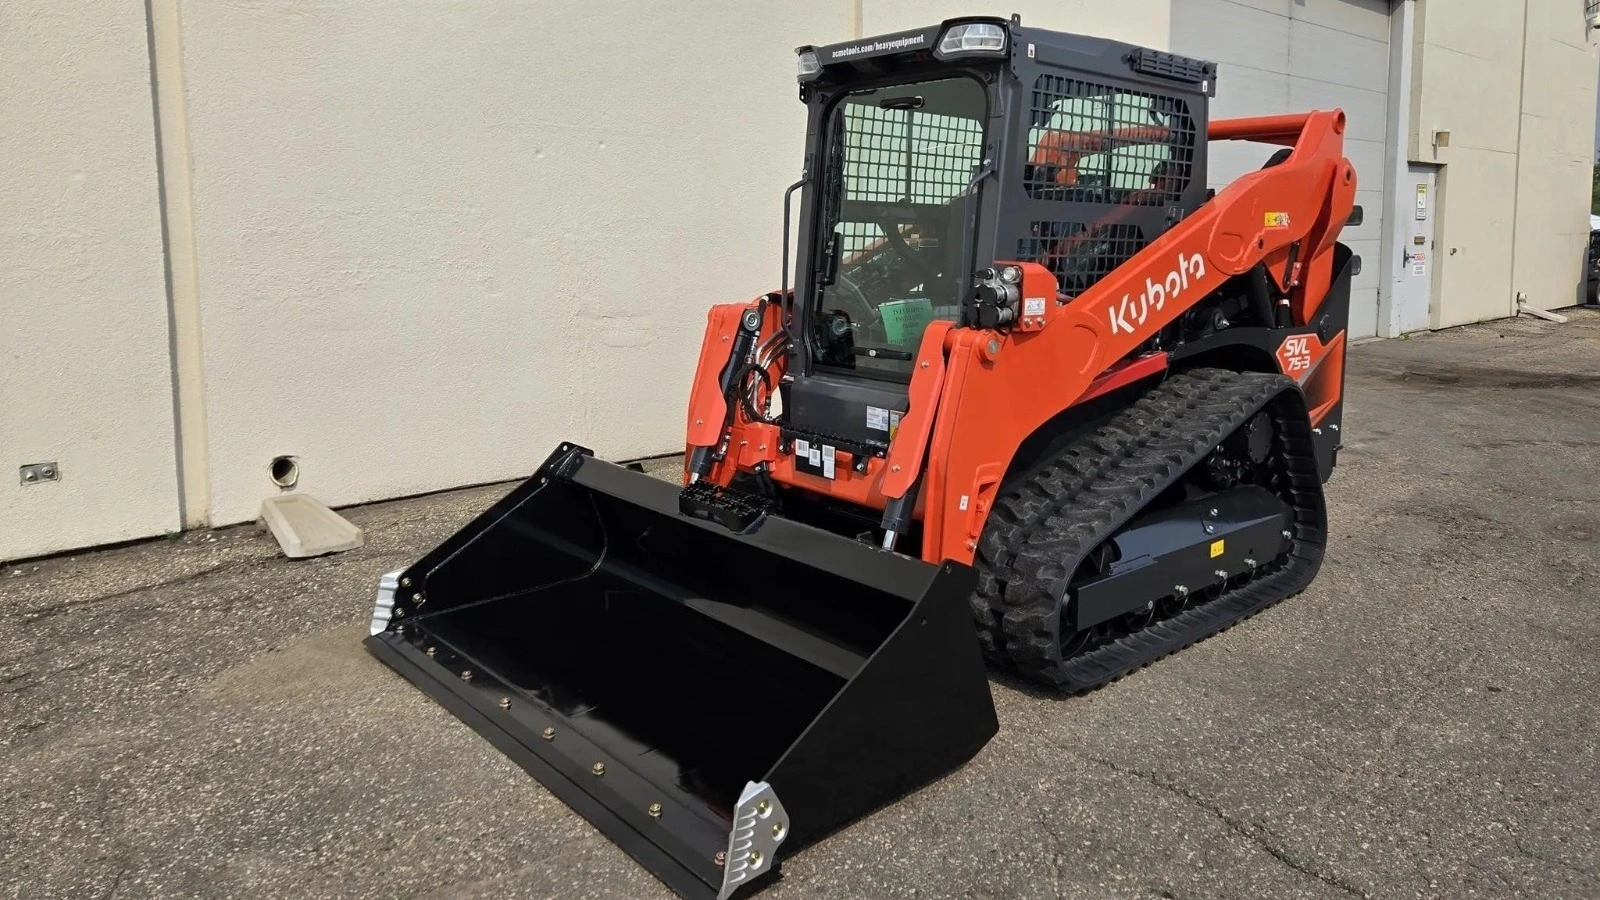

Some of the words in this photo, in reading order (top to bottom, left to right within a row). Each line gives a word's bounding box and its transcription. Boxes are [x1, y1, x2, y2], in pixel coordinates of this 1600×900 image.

[832, 34, 924, 58] acmetools.com/heavyequipment
[1109, 252, 1205, 335] Kubota
[1284, 338, 1310, 357] SVL
[1288, 355, 1310, 371] 75-3
